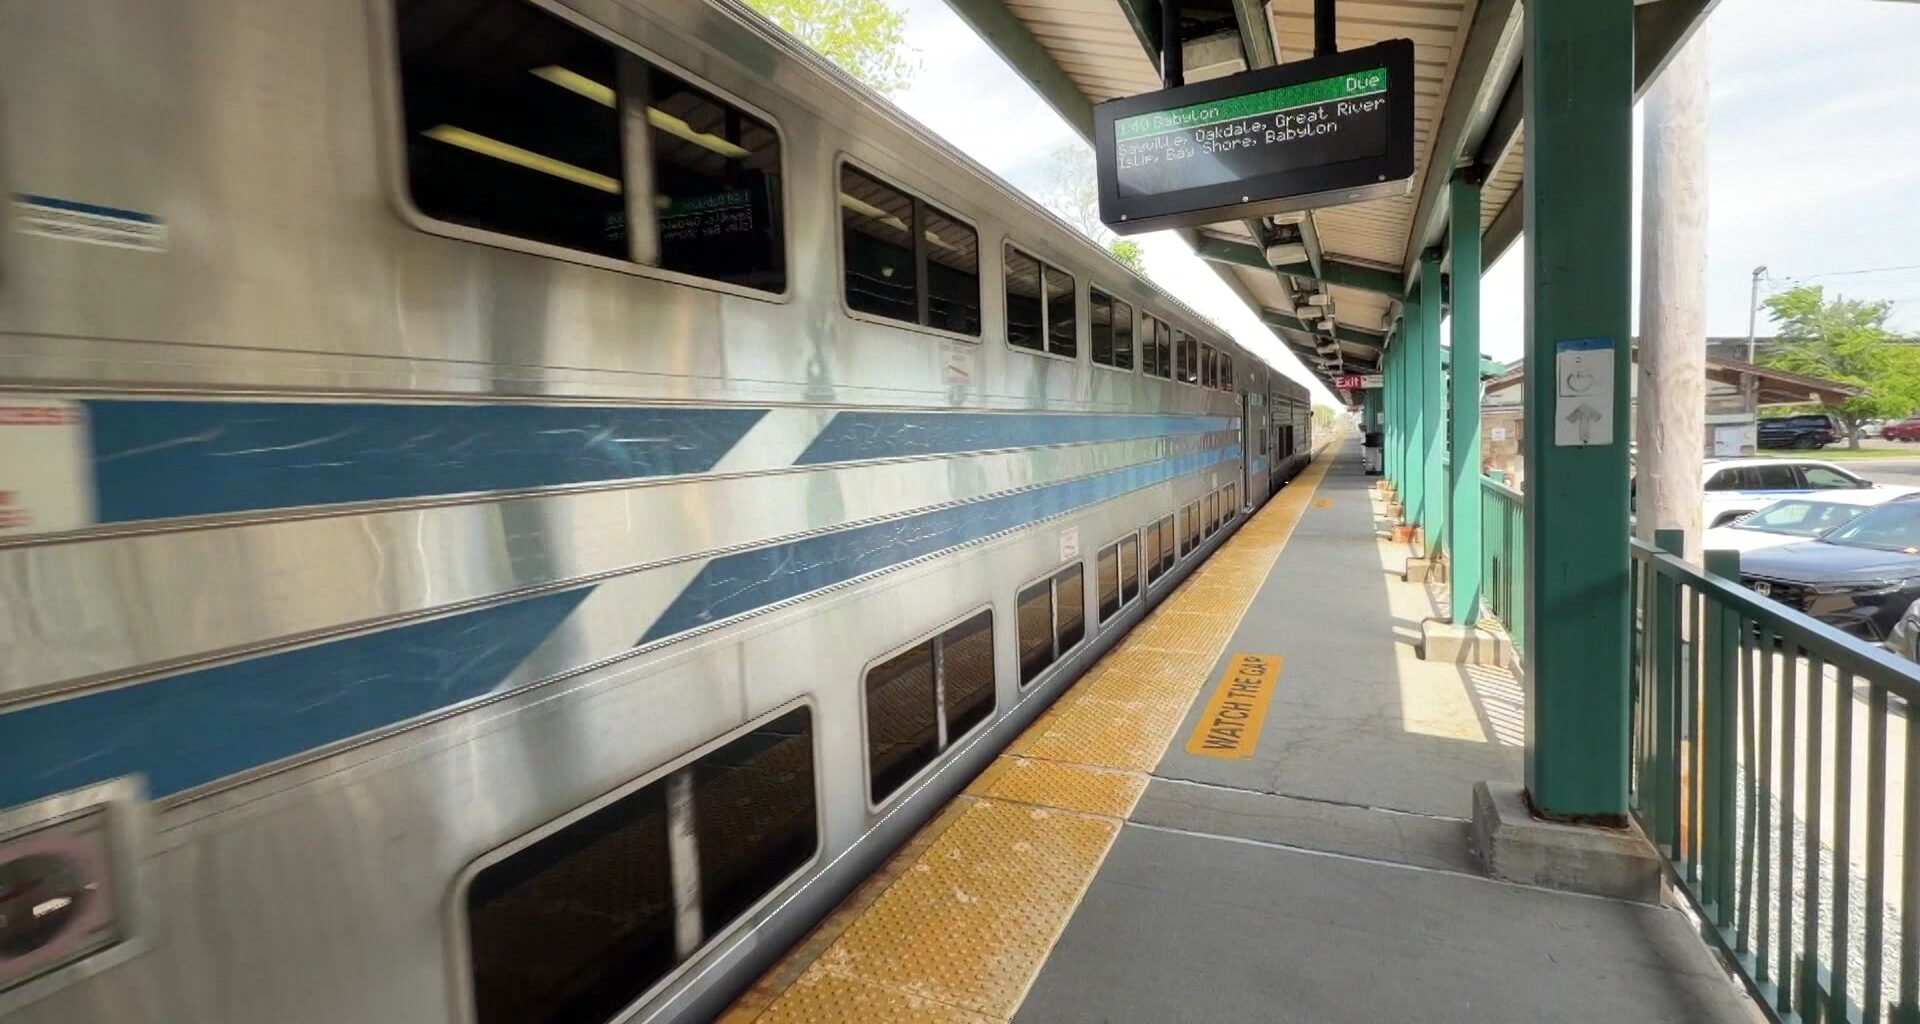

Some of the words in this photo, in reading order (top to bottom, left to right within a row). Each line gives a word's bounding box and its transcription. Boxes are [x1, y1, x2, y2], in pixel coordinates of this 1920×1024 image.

[1153, 108, 1219, 128] Babylon
[1346, 75, 1380, 92] Due
[1195, 121, 1266, 142] Oakdale,
[1275, 106, 1328, 128] Great
[1337, 98, 1385, 117] River
[1166, 147, 1195, 161] Bay
[1202, 138, 1257, 154] Shore,
[1265, 121, 1337, 144] Babylon
[1336, 376, 1358, 388] Exit
[1239, 656, 1268, 676] GAP
[1227, 678, 1262, 698] THE
[1202, 701, 1254, 749] WATCH
